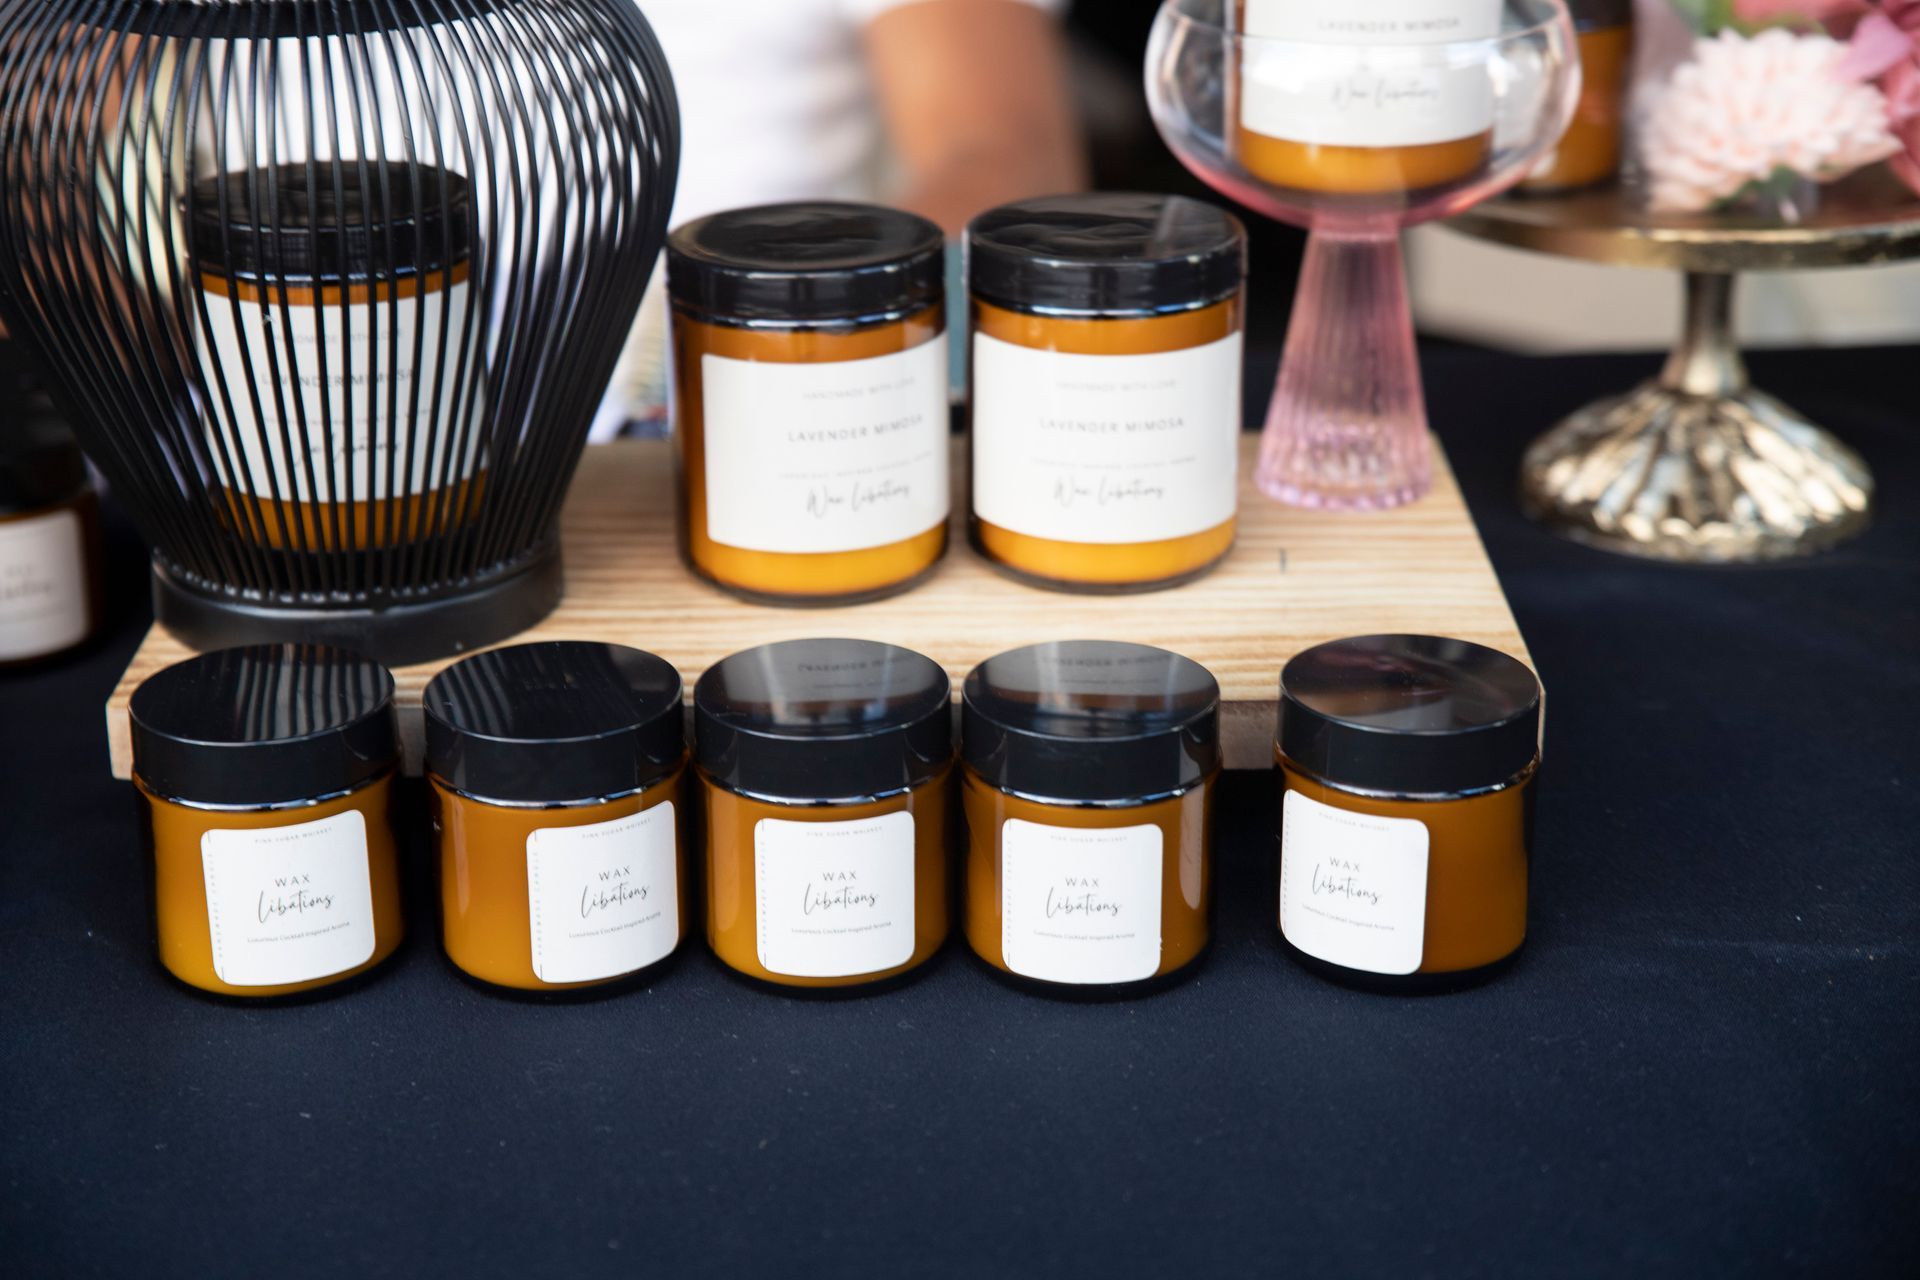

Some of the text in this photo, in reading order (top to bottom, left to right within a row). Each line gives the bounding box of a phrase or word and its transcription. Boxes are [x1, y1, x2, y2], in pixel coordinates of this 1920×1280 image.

[788, 413, 924, 443] LAVENDER MIMOSA
[1038, 416, 1185, 433] LAVENDER MIMOSA
[598, 864, 632, 881] WAX
[1329, 856, 1361, 872] WAX
[273, 872, 311, 888] WAX
[822, 870, 858, 882] WAX
[1064, 877, 1100, 888] WAX
[1311, 863, 1381, 906] Libations
[257, 889, 336, 924] Libations
[580, 882, 650, 919] Libations
[803, 883, 879, 916] Libations
[1045, 886, 1122, 919] Libations
[280, 932, 304, 941] Cocktail
[305, 927, 330, 936] Inspired
[331, 921, 351, 930] Aroma
